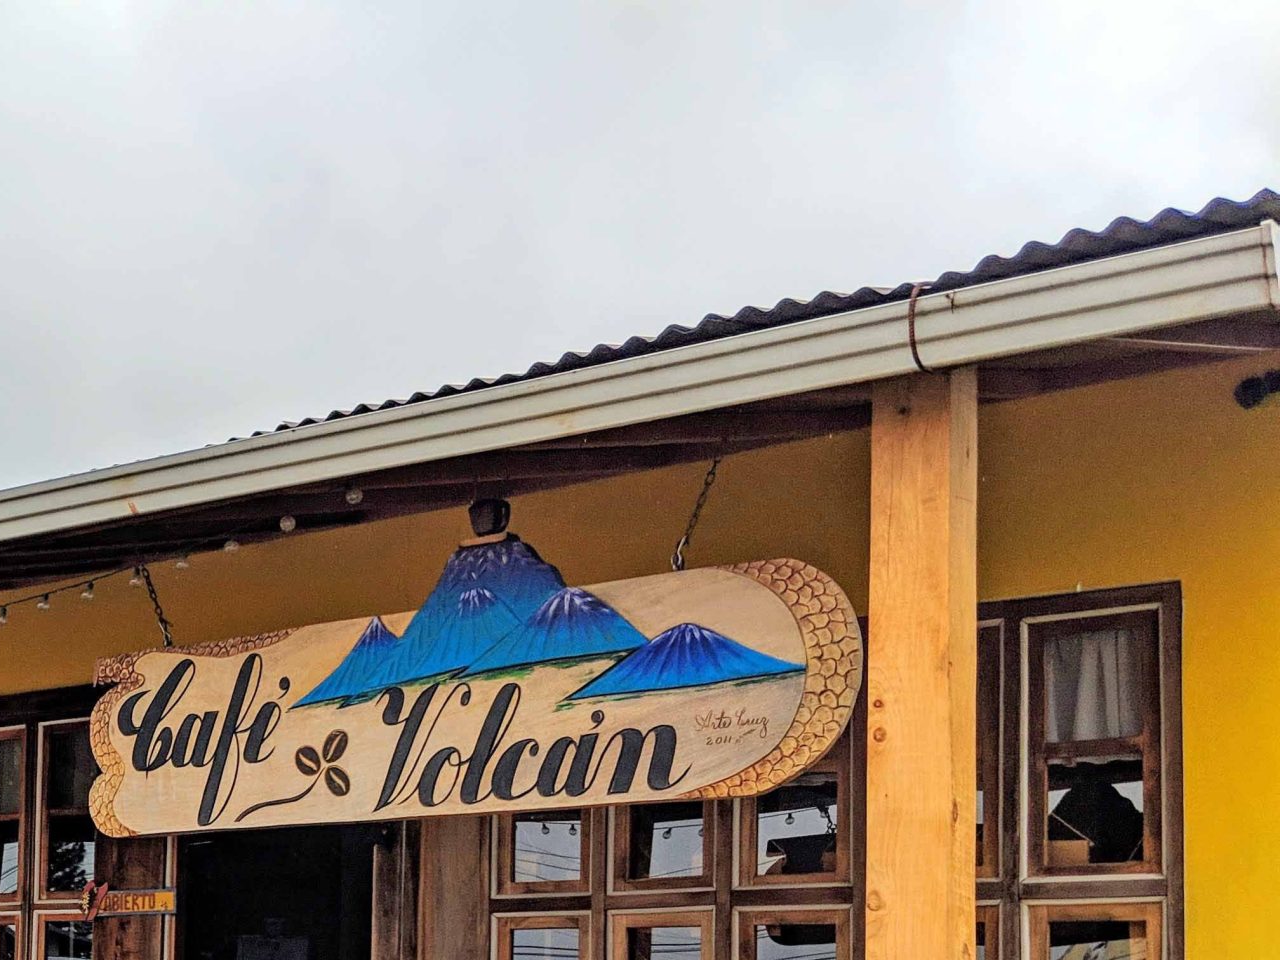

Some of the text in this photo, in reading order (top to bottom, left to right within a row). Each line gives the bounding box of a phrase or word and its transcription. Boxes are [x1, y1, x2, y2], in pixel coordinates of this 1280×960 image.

[117, 653, 693, 827] Café Volcán
[101, 892, 156, 912] ABIERTO
